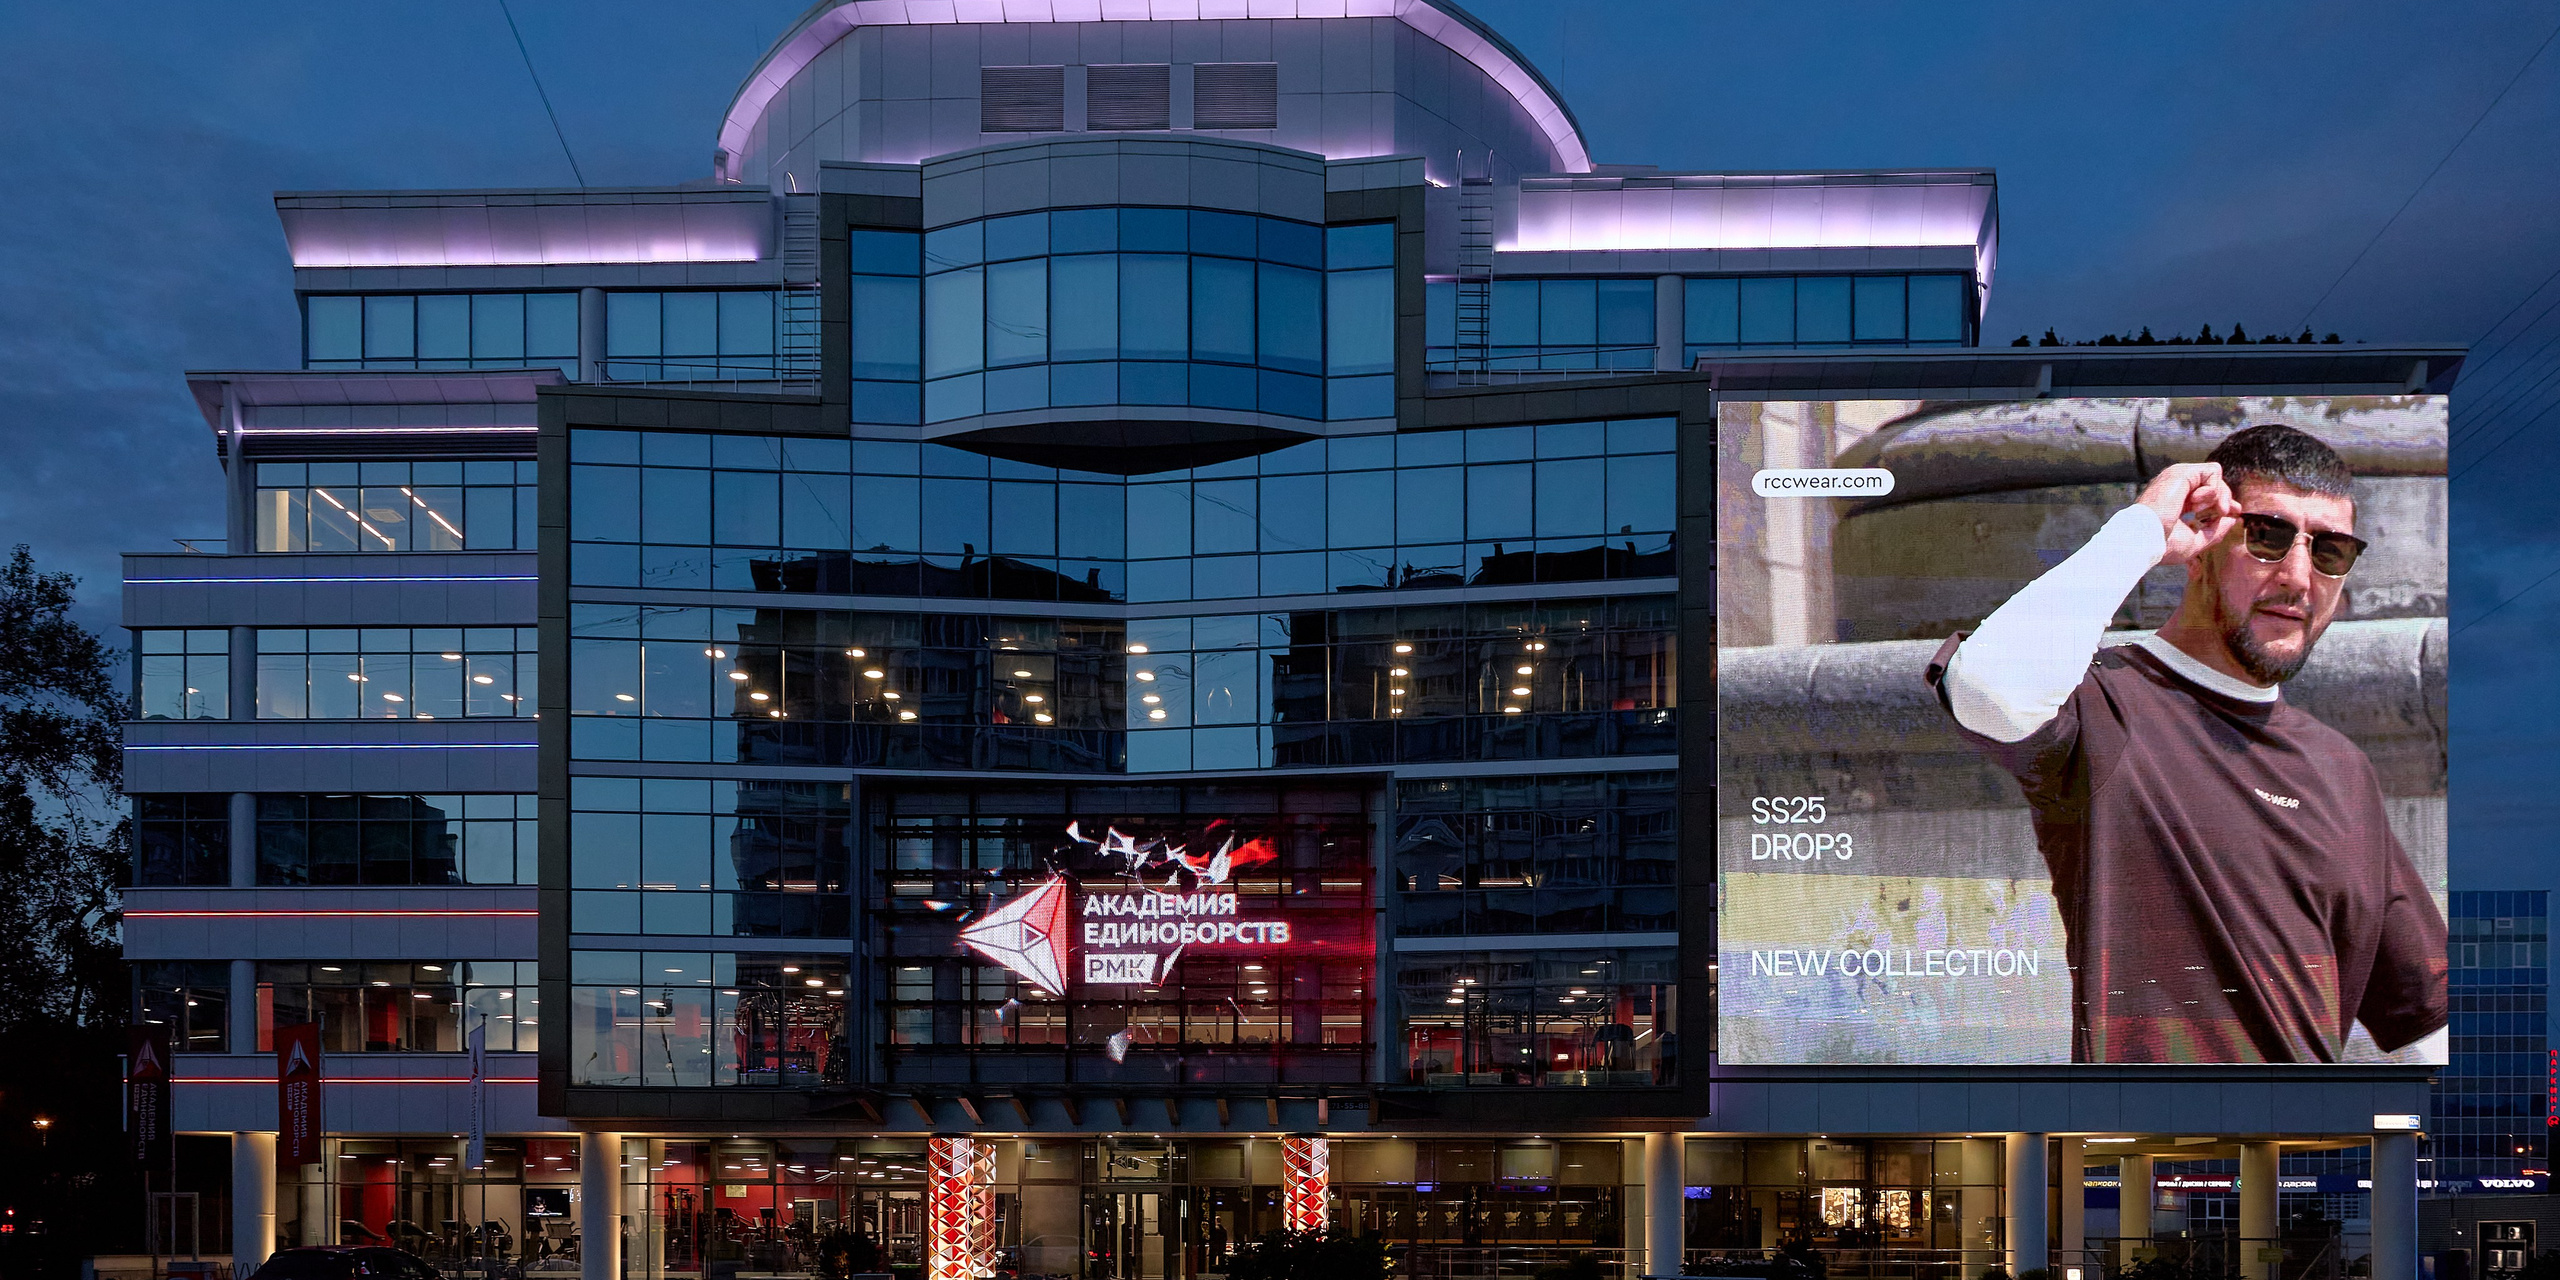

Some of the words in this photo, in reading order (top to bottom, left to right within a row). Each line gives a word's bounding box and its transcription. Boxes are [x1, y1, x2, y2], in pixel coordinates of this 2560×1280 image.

[1764, 475, 1882, 489] rccwear.com
[1751, 796, 1826, 825] SS25
[1751, 833, 1853, 861] DROP3
[1083, 893, 1237, 920] АКАДЕМИЯ
[1084, 922, 1291, 948] ЕДИНОБОРСТВ
[1088, 957, 1147, 979] РМК
[1751, 950, 1831, 977] NEW
[1839, 949, 2039, 977] COLLECTION
[2549, 1049, 2558, 1113] ПАРКИНГ
[147, 1083, 158, 1141] АКАДЕМИЯ
[300, 1080, 309, 1138] АКАДЕМИЯ
[2282, 1180, 2317, 1188] даром
[2478, 1178, 2536, 1189] VOLVO
